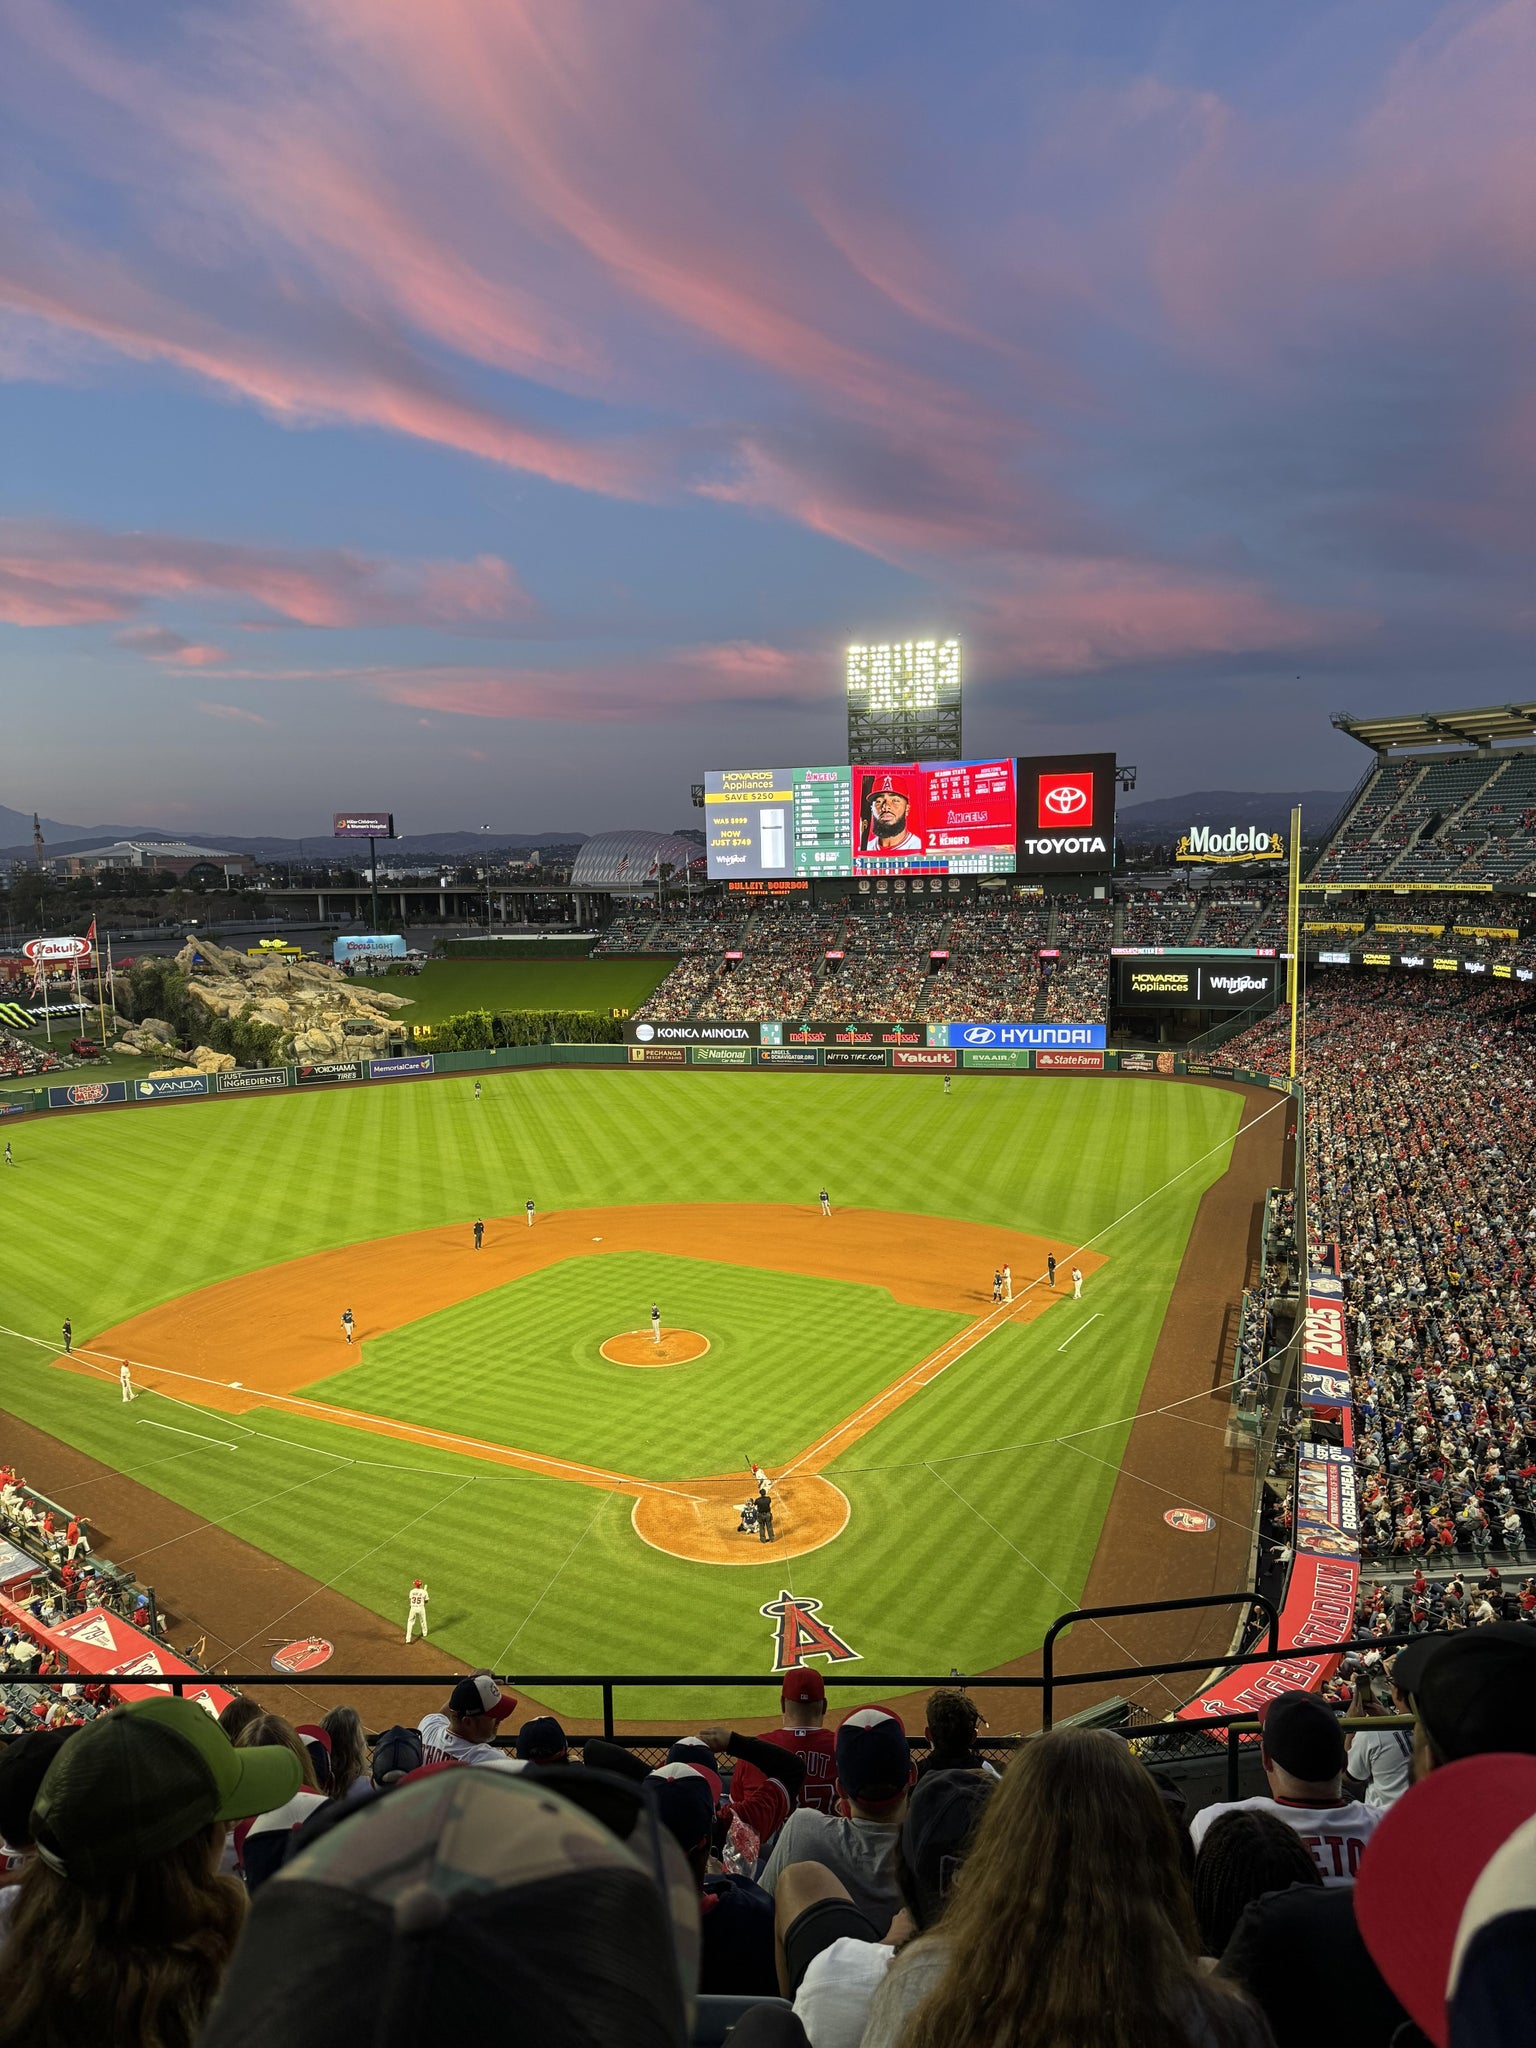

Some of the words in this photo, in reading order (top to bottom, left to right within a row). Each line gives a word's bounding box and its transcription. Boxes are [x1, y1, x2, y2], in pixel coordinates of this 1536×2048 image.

[722, 772, 774, 780] HOWARDS
[806, 770, 837, 782] ANGELS
[722, 781, 774, 790] Appliances
[947, 810, 988, 824] ANGELS
[929, 834, 936, 846] 2
[940, 836, 970, 845] RENGIFO
[1190, 826, 1269, 853] Modelo
[1025, 837, 1106, 855] TOYOTA
[716, 855, 747, 866] Whirlpool
[728, 882, 764, 890] BULLEIT
[768, 881, 808, 889] BOURBON
[347, 942, 371, 950] Coors
[1132, 974, 1188, 983] HOWARDS
[1132, 982, 1188, 993] Appliances
[1210, 976, 1268, 994] Whirlpool
[26, 1003, 92, 1014] MONSTER
[614, 1009, 628, 1017] 0:14
[414, 1026, 431, 1035] 0:14
[658, 1028, 699, 1038] KONICA
[701, 1029, 749, 1038] MINOLTA
[1001, 1029, 1092, 1044] HYUNDAI
[708, 1050, 746, 1059] National
[898, 1053, 952, 1063] Yakult
[1054, 1055, 1076, 1064] State
[1078, 1056, 1100, 1065] Farm
[314, 1064, 356, 1074] YOKOHAMA
[374, 1063, 420, 1072] MemorialCare
[155, 1080, 204, 1091] VANDA
[223, 1075, 282, 1087] INGREDIENTS
[73, 1084, 102, 1093] Jersey
[1304, 1307, 1343, 1356] 2025
[1329, 1446, 1351, 1462] 8TH
[1341, 1464, 1356, 1530] BOBBLEHEAD
[1292, 1562, 1353, 1650] STADIUM
